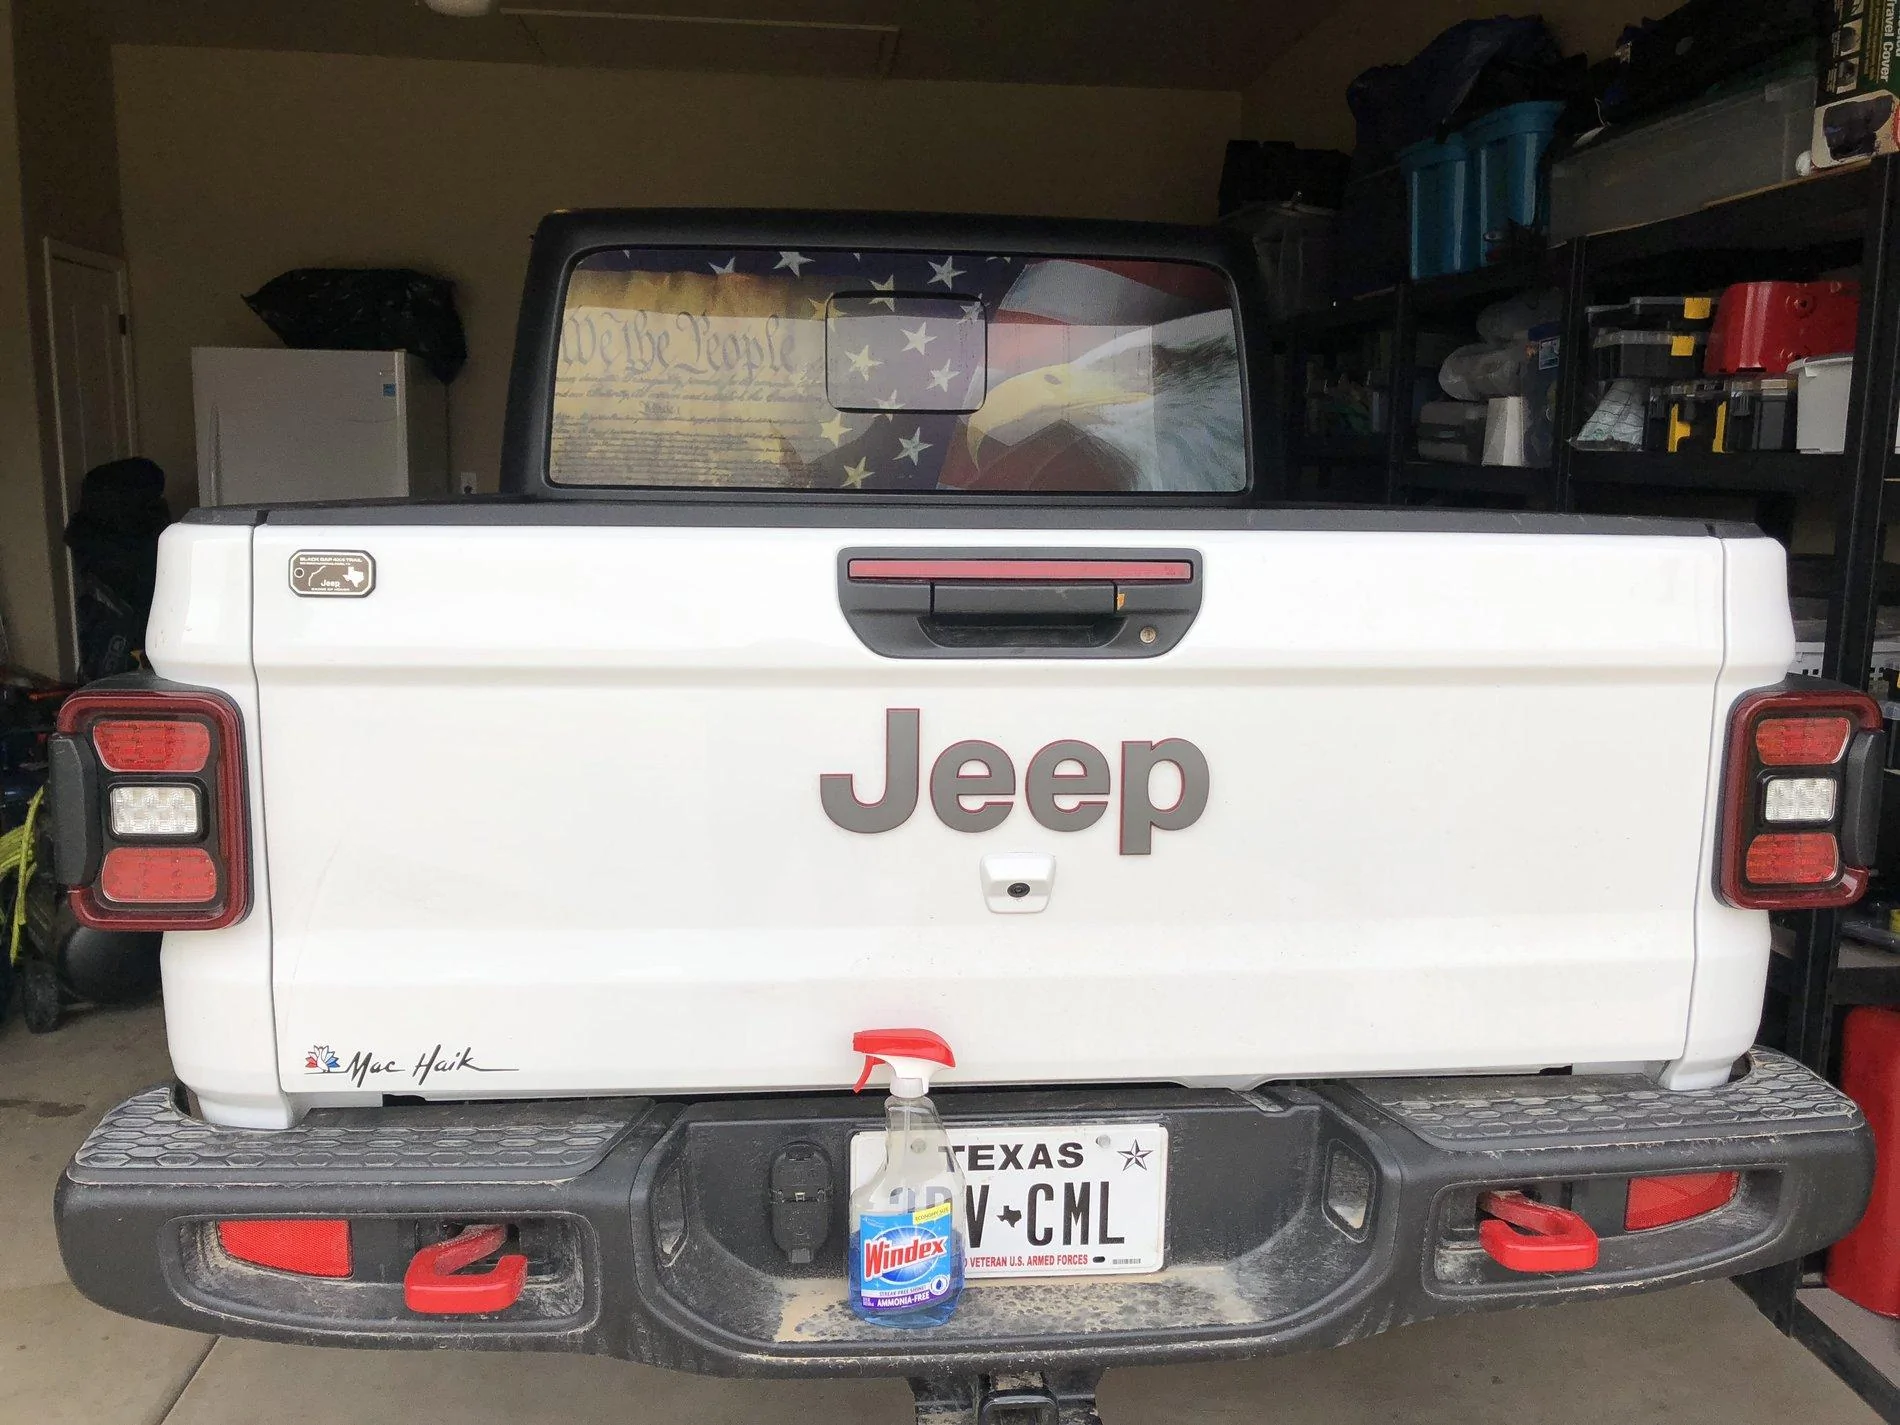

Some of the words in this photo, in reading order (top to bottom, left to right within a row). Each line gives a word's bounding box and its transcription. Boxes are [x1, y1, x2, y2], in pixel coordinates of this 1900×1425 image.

[1880, 41, 1894, 82] Cover
[561, 311, 617, 368] We
[671, 311, 800, 378] People
[320, 579, 340, 588] Jeep
[819, 707, 1211, 856] Jeep
[346, 1050, 405, 1088] Mac
[411, 1043, 519, 1086] Haik
[938, 1142, 1084, 1173] TEXAS
[1026, 1181, 1125, 1247] CML
[864, 1237, 947, 1280] Windex
[970, 1256, 1007, 1268] VETERAN
[1008, 1256, 1025, 1267] U.S.
[1027, 1255, 1055, 1267] ARMED
[1057, 1254, 1088, 1266] FORCES
[877, 1291, 930, 1307] AMMONIA-FREE
